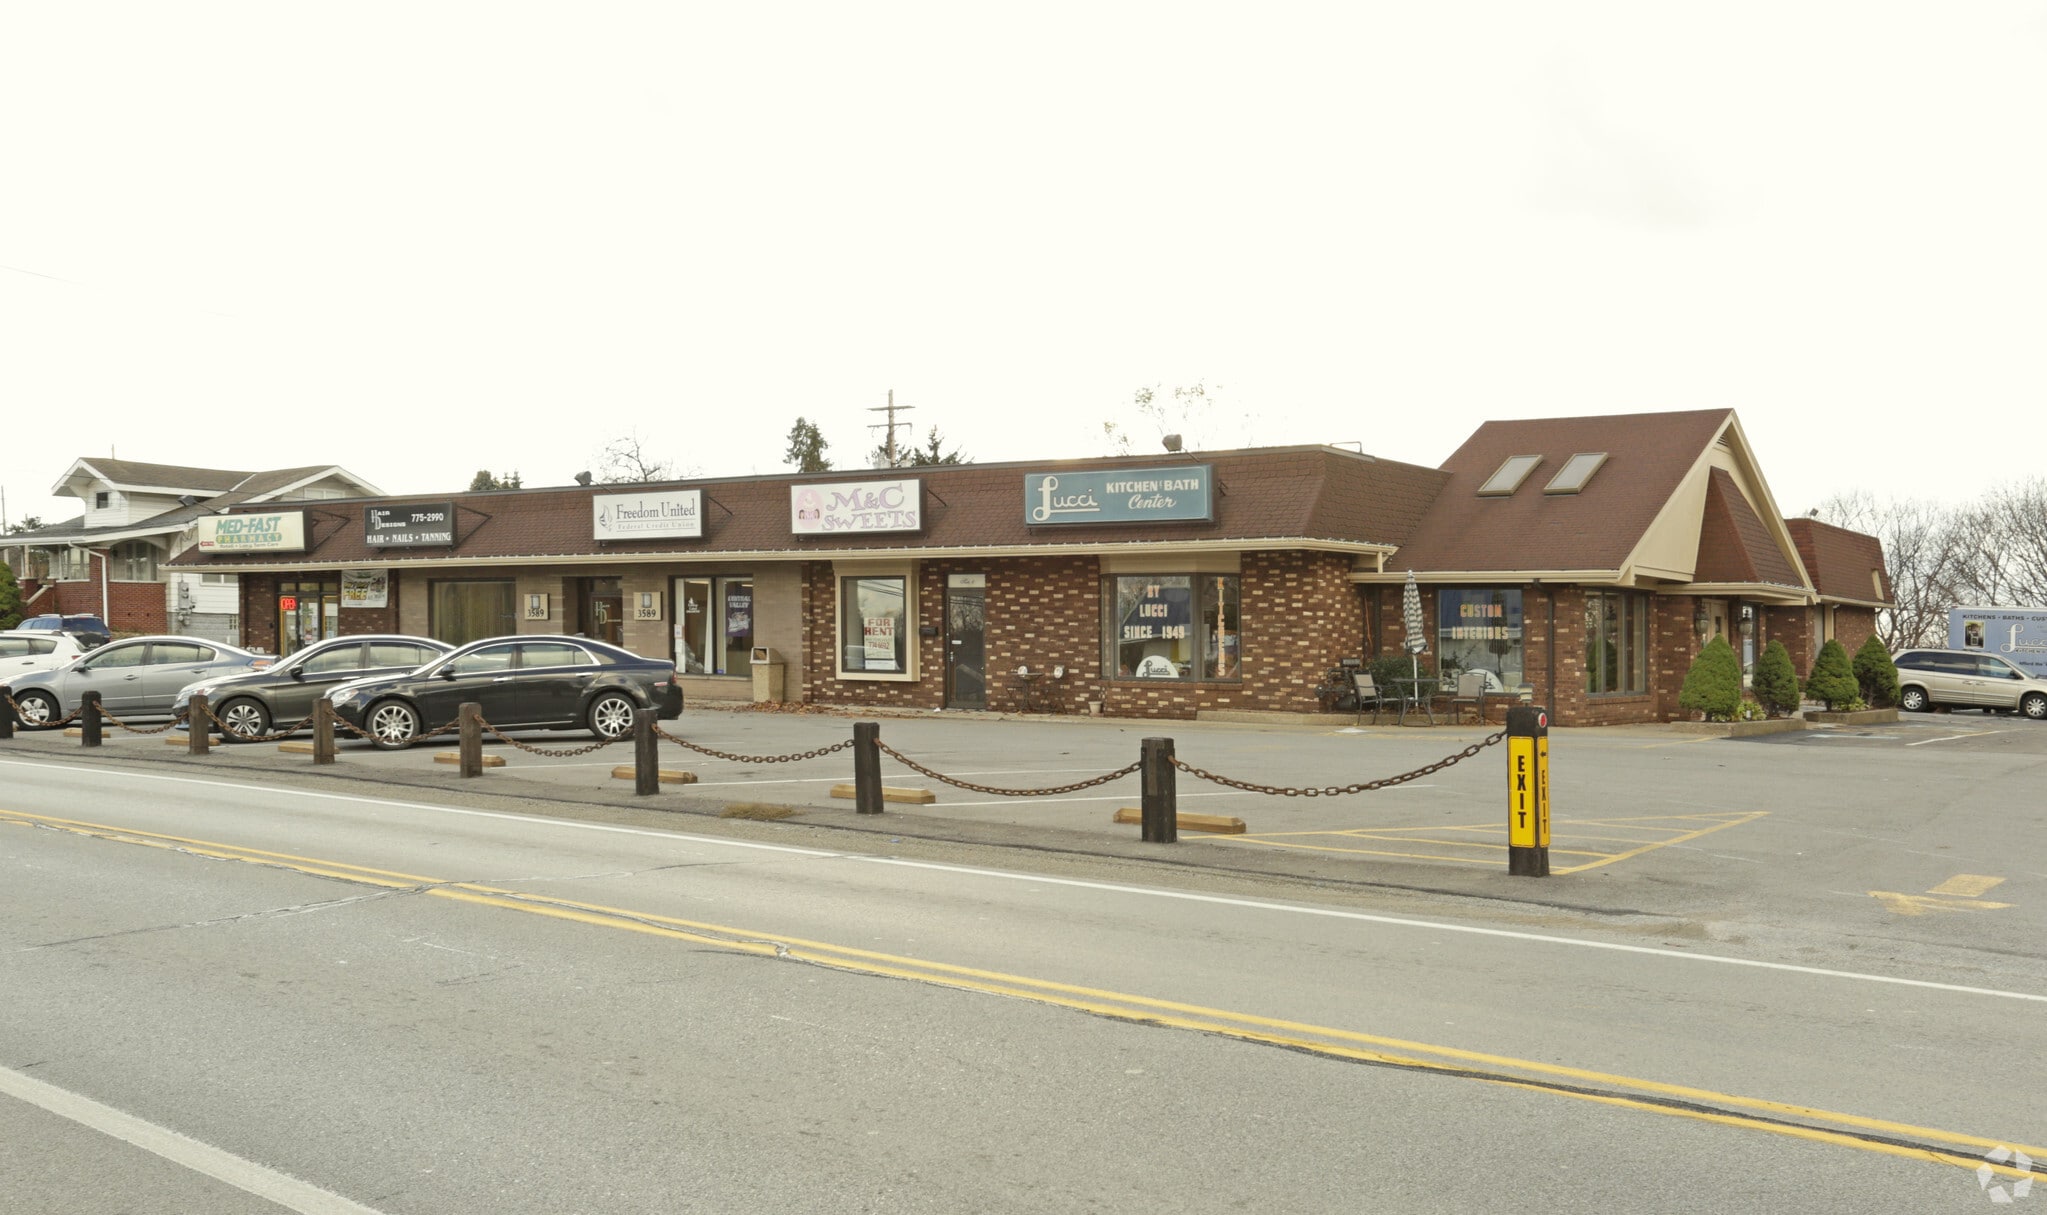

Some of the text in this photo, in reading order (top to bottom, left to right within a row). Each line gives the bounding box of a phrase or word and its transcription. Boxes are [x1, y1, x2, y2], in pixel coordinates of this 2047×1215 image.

[1106, 481, 1158, 494] KITCHEN
[1163, 479, 1199, 491] BATH
[826, 483, 905, 511] M&C
[1032, 475, 1098, 521] Lucci
[1128, 493, 1177, 510] Center
[616, 497, 696, 519] Freedom United
[411, 513, 444, 522] 775-2990
[822, 511, 917, 531] SWEETS
[216, 517, 282, 534] MED-FAST
[217, 533, 281, 544] PHARMACY
[366, 532, 451, 543] HAIR NAILS TANNING
[1147, 585, 1160, 598] BY
[528, 609, 544, 618] 3589
[638, 609, 656, 618] 3589
[1139, 604, 1168, 618] LUCCI
[1460, 604, 1502, 618] CUSTOM
[868, 618, 890, 627] FOR
[864, 627, 893, 636] RENT
[1124, 625, 1185, 639] SINCE 1949
[1452, 626, 1509, 640] INTERIORS
[1517, 755, 1527, 829] EXIT
